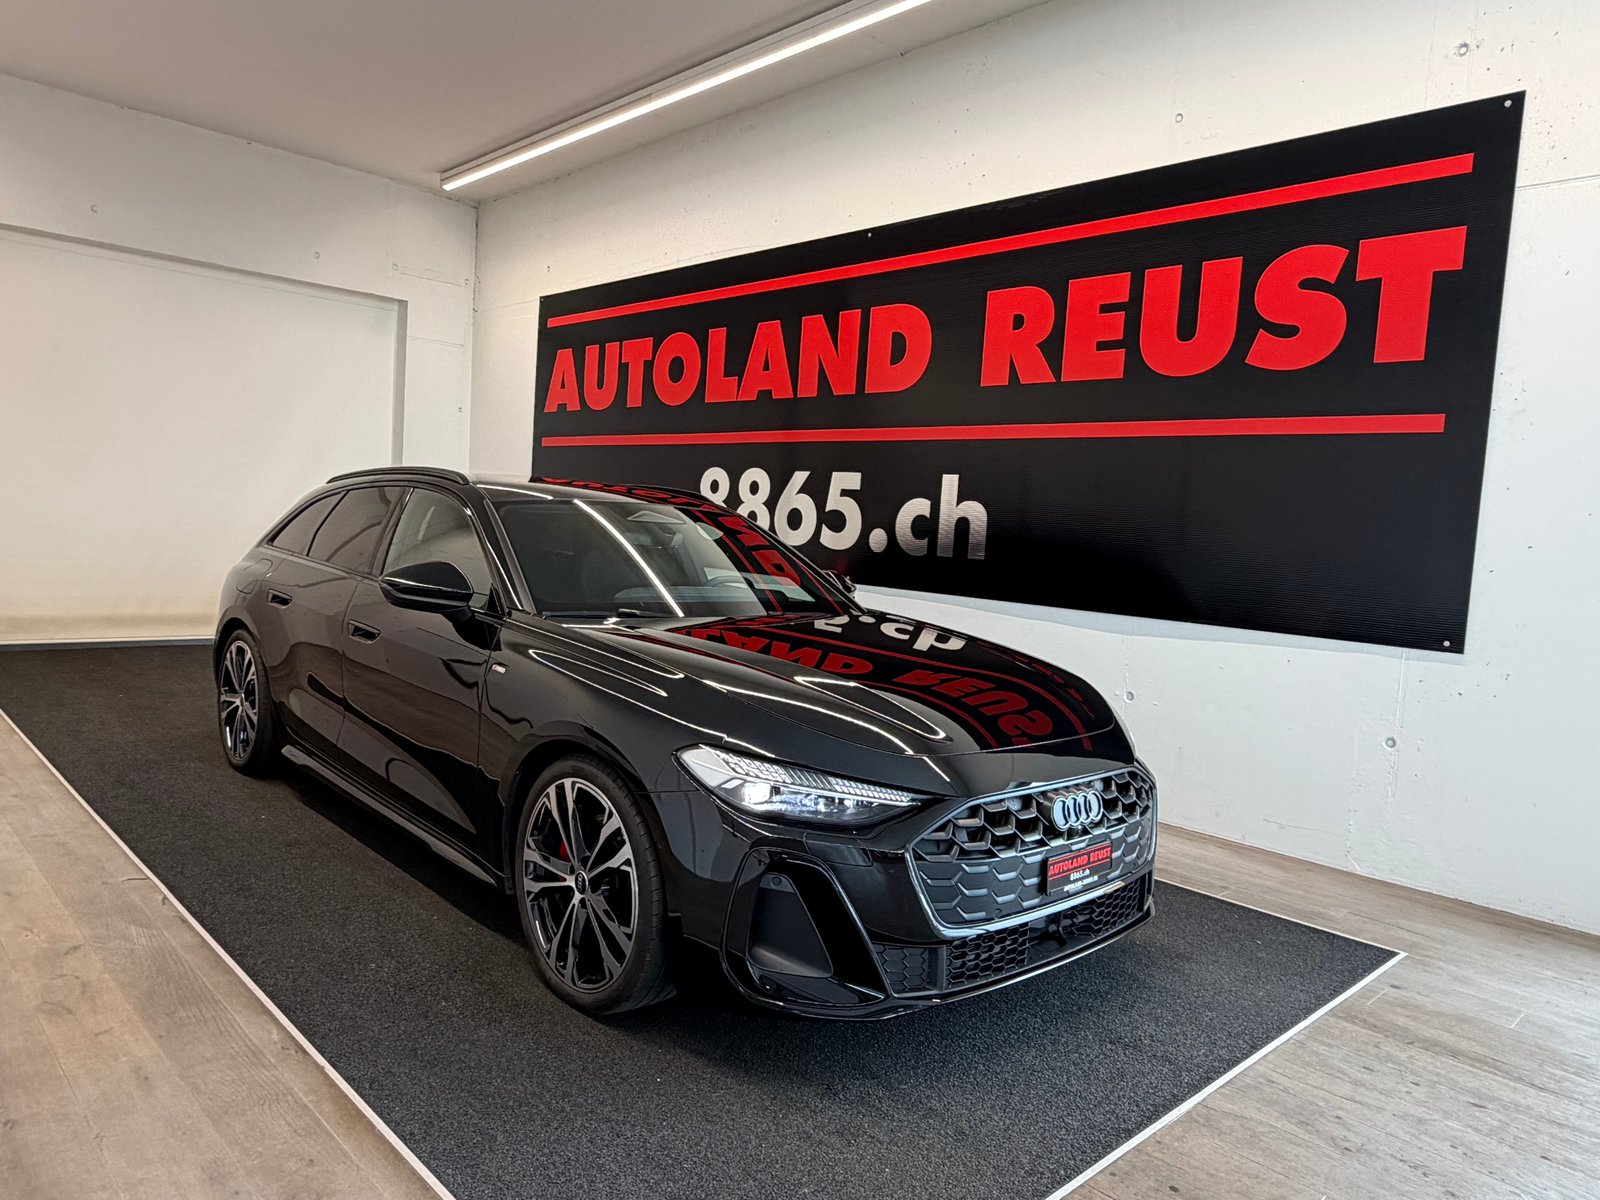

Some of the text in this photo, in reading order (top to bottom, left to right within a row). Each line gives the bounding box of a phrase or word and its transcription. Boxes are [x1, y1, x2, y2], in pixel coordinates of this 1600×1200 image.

[544, 225, 1468, 413] AUTOLAND REUST
[700, 467, 988, 560] 8865.ch
[1048, 846, 1111, 875] AUTOLAND REUST
